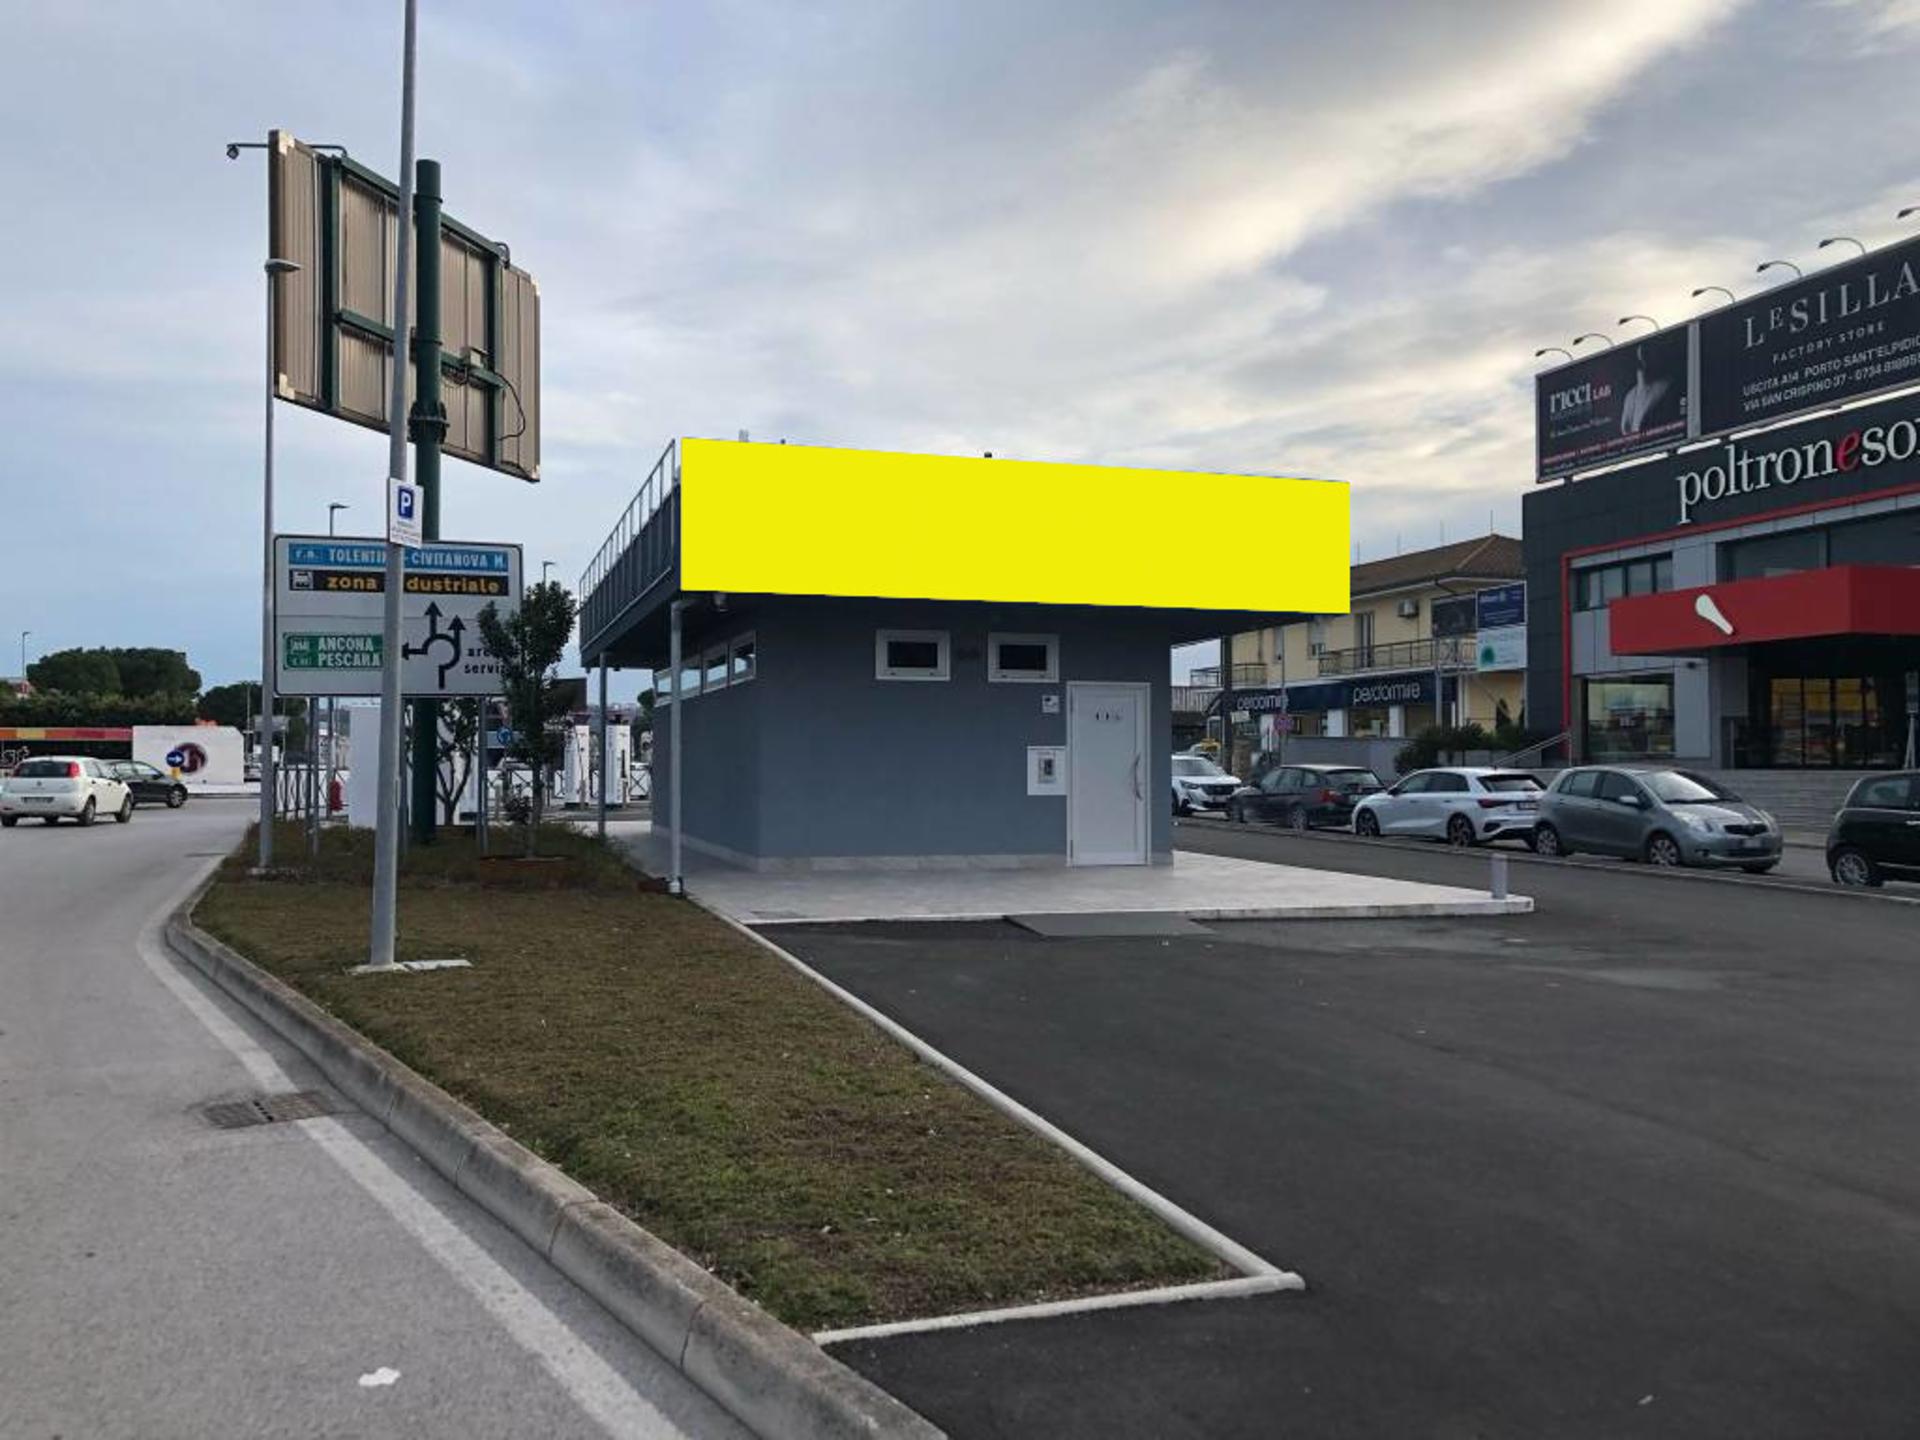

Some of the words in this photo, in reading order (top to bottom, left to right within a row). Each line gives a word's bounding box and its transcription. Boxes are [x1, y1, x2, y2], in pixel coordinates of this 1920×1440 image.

[1772, 338, 1834, 364] FACTORY
[1838, 321, 1883, 343] STORE
[1804, 357, 1841, 378] PORTO
[1676, 420, 1920, 525] poltroneso
[400, 491, 412, 514] P
[330, 547, 386, 564] TOLENTI
[411, 550, 488, 568] CIVITANOVA
[327, 576, 378, 590] zona
[406, 576, 499, 593] dustriale
[318, 637, 374, 652] ANCONA
[318, 652, 381, 667] PESCARA
